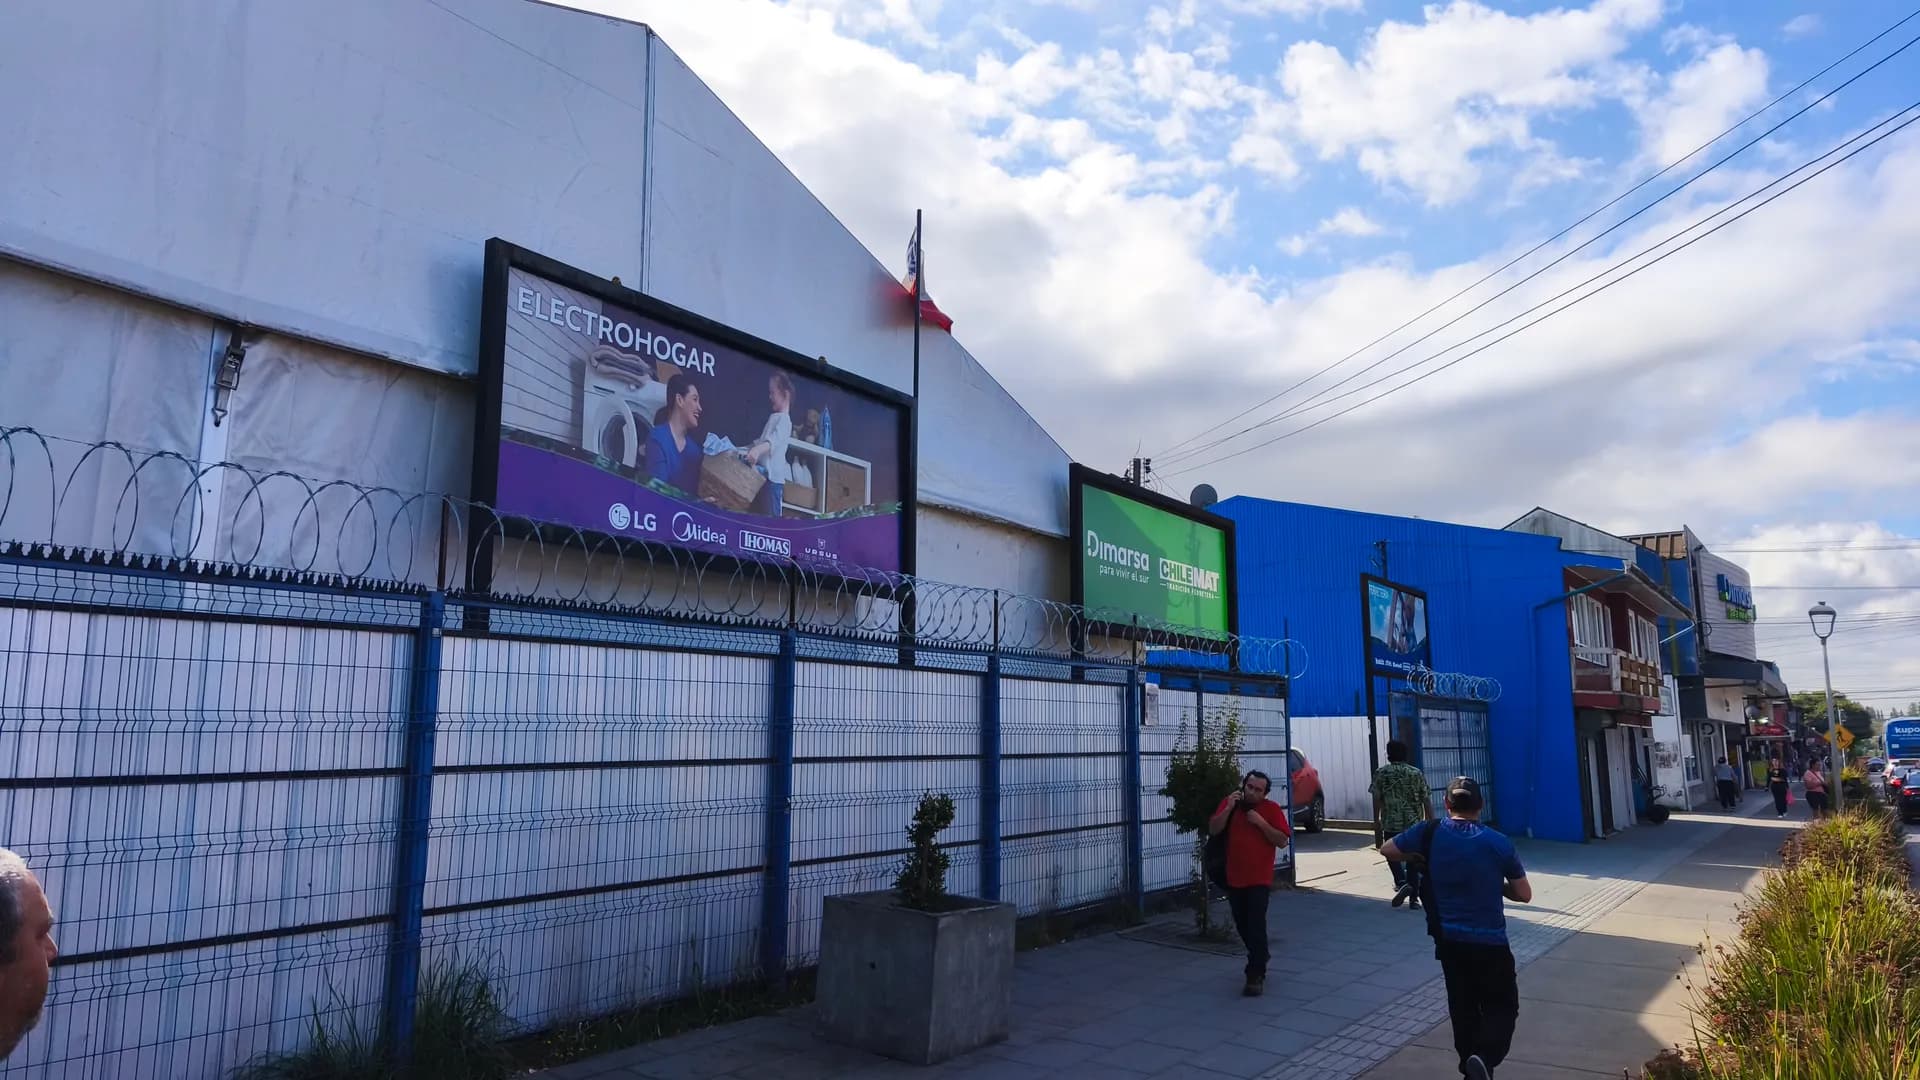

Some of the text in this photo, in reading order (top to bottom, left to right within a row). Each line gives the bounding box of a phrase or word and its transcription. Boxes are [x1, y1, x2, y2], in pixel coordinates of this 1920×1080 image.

[516, 286, 716, 377] ELECTROHOGAR
[633, 510, 657, 532] LG
[673, 513, 727, 545] Midea
[743, 531, 789, 556] THOMAS
[804, 547, 838, 560] URSUS
[1087, 529, 1150, 572] Dimarsa
[1099, 564, 1115, 577] para
[1131, 570, 1138, 581] el
[1139, 574, 1150, 584] sur
[1160, 558, 1220, 593] CHILEMAT
[1895, 726, 1920, 735] kupo
